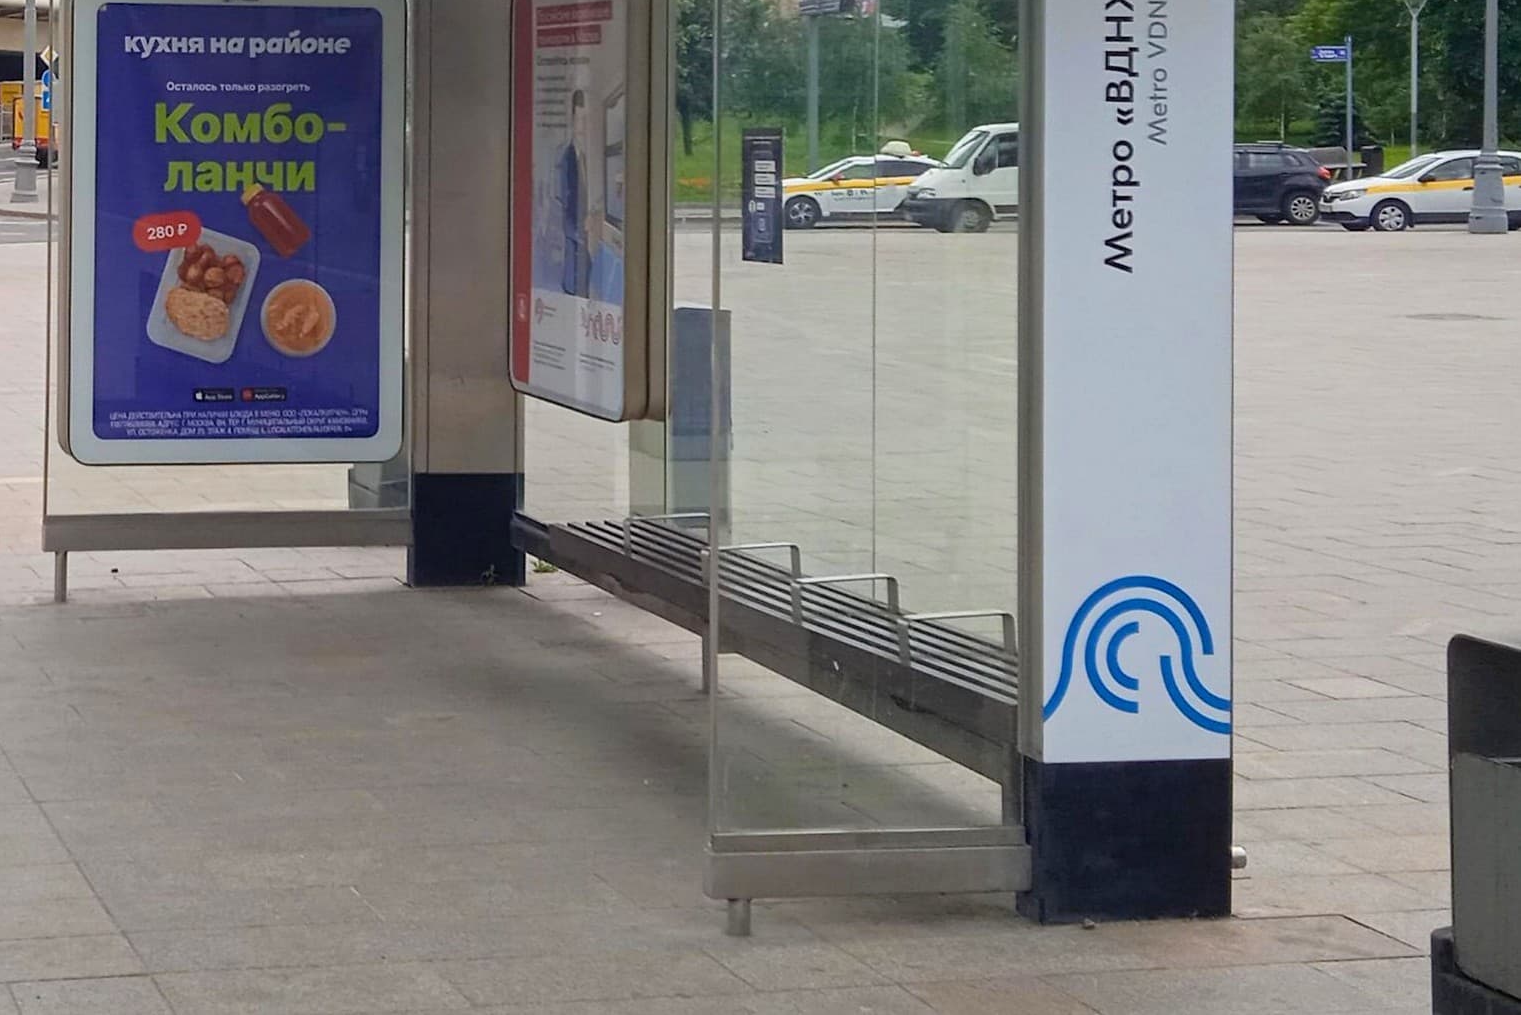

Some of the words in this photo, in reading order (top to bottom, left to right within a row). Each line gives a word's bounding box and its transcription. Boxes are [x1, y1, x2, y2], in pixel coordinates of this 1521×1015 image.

[124, 35, 205, 58] кухня
[210, 38, 246, 54] на
[249, 30, 352, 58] районе
[166, 81, 218, 92] Осталось
[220, 82, 256, 93] только
[257, 83, 311, 94] разогреть
[154, 101, 347, 144] Комбо-
[1146, 67, 1169, 146] Metro
[163, 160, 316, 192] ланчи
[1103, 138, 1141, 274] Метро
[146, 225, 175, 241] 280
